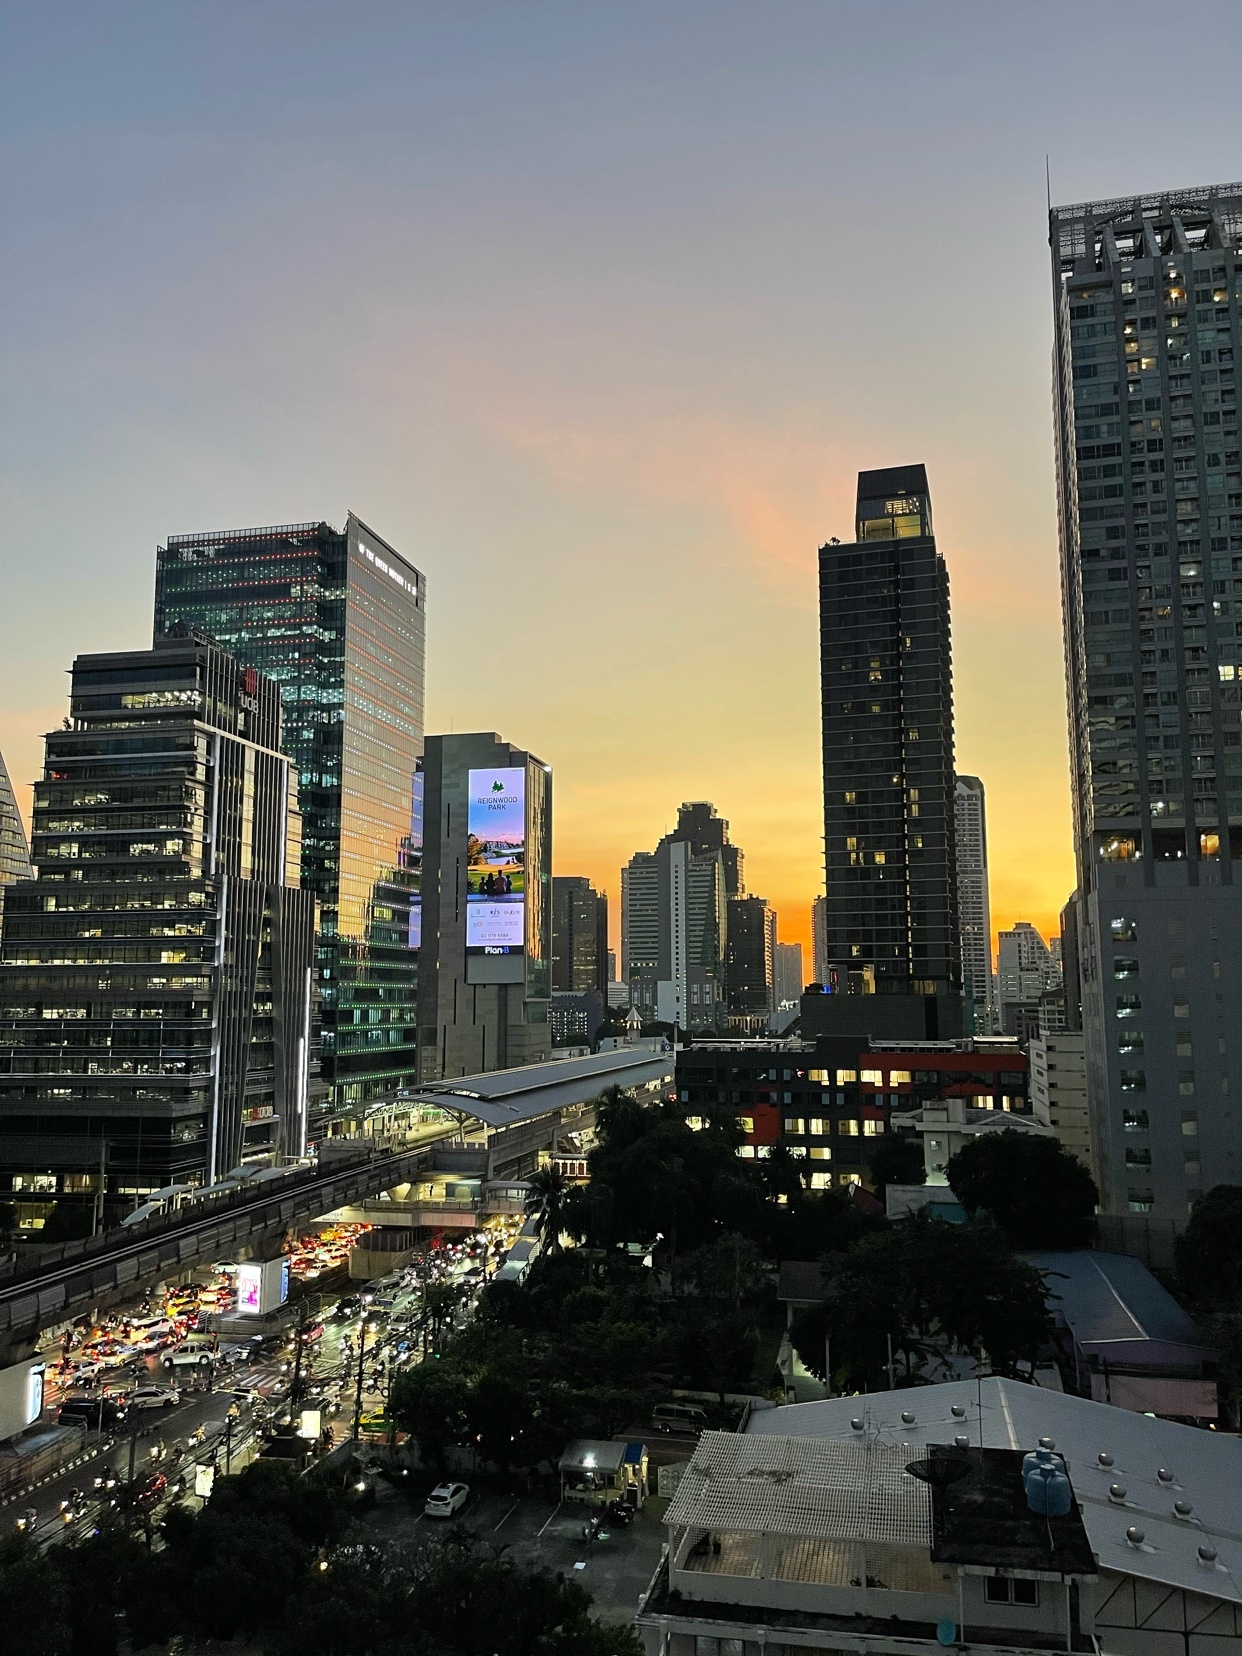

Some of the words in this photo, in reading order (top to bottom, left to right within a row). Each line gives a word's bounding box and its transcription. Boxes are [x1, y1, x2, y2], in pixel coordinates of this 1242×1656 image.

[366, 549, 374, 562] THE
[375, 557, 388, 574] QUEEN
[389, 567, 404, 587] MOTHER
[241, 694, 259, 713] UOB
[477, 796, 518, 804] REIGNWOOD
